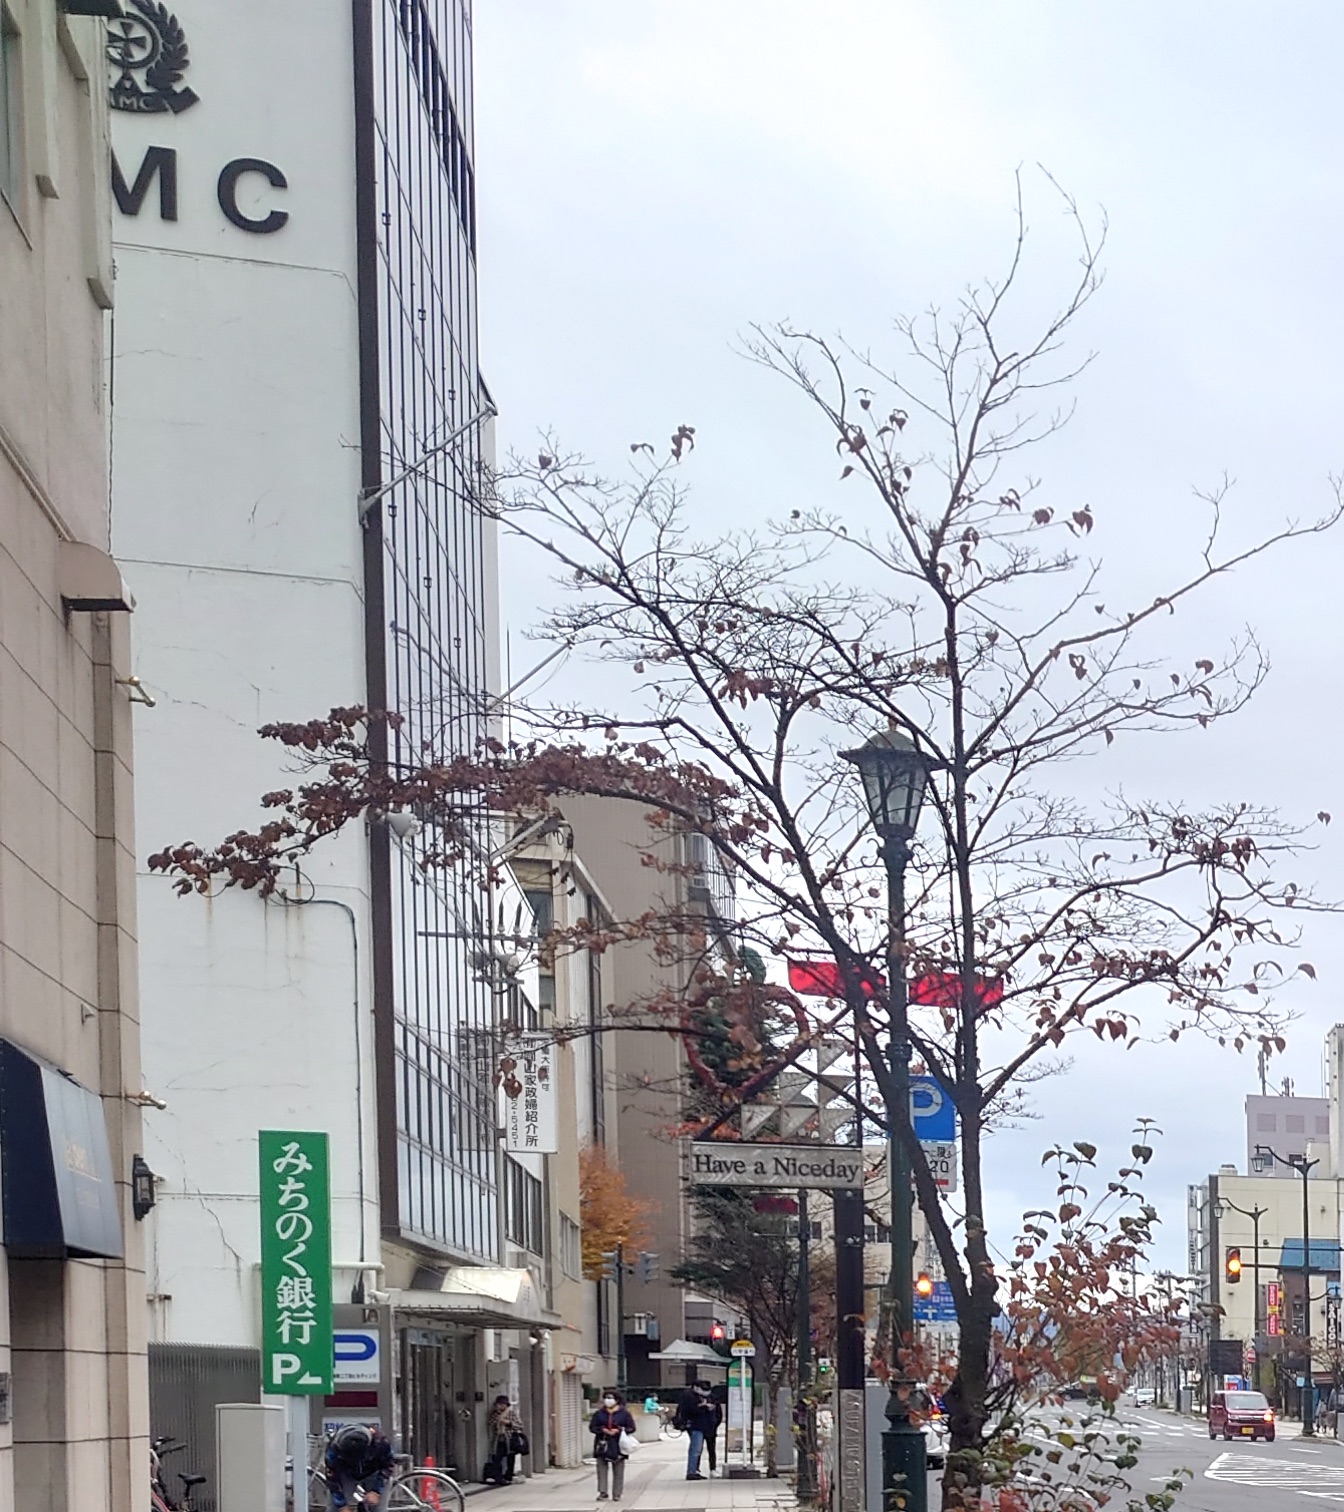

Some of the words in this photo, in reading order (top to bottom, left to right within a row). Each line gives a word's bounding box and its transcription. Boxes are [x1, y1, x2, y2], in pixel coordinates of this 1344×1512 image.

[909, 1082, 942, 1131] P
[694, 1153, 746, 1175] Have
[754, 1160, 766, 1175] a
[773, 1157, 861, 1183] Niceday
[273, 1141, 317, 1344] みちのく銀行
[272, 1353, 300, 1384] P
